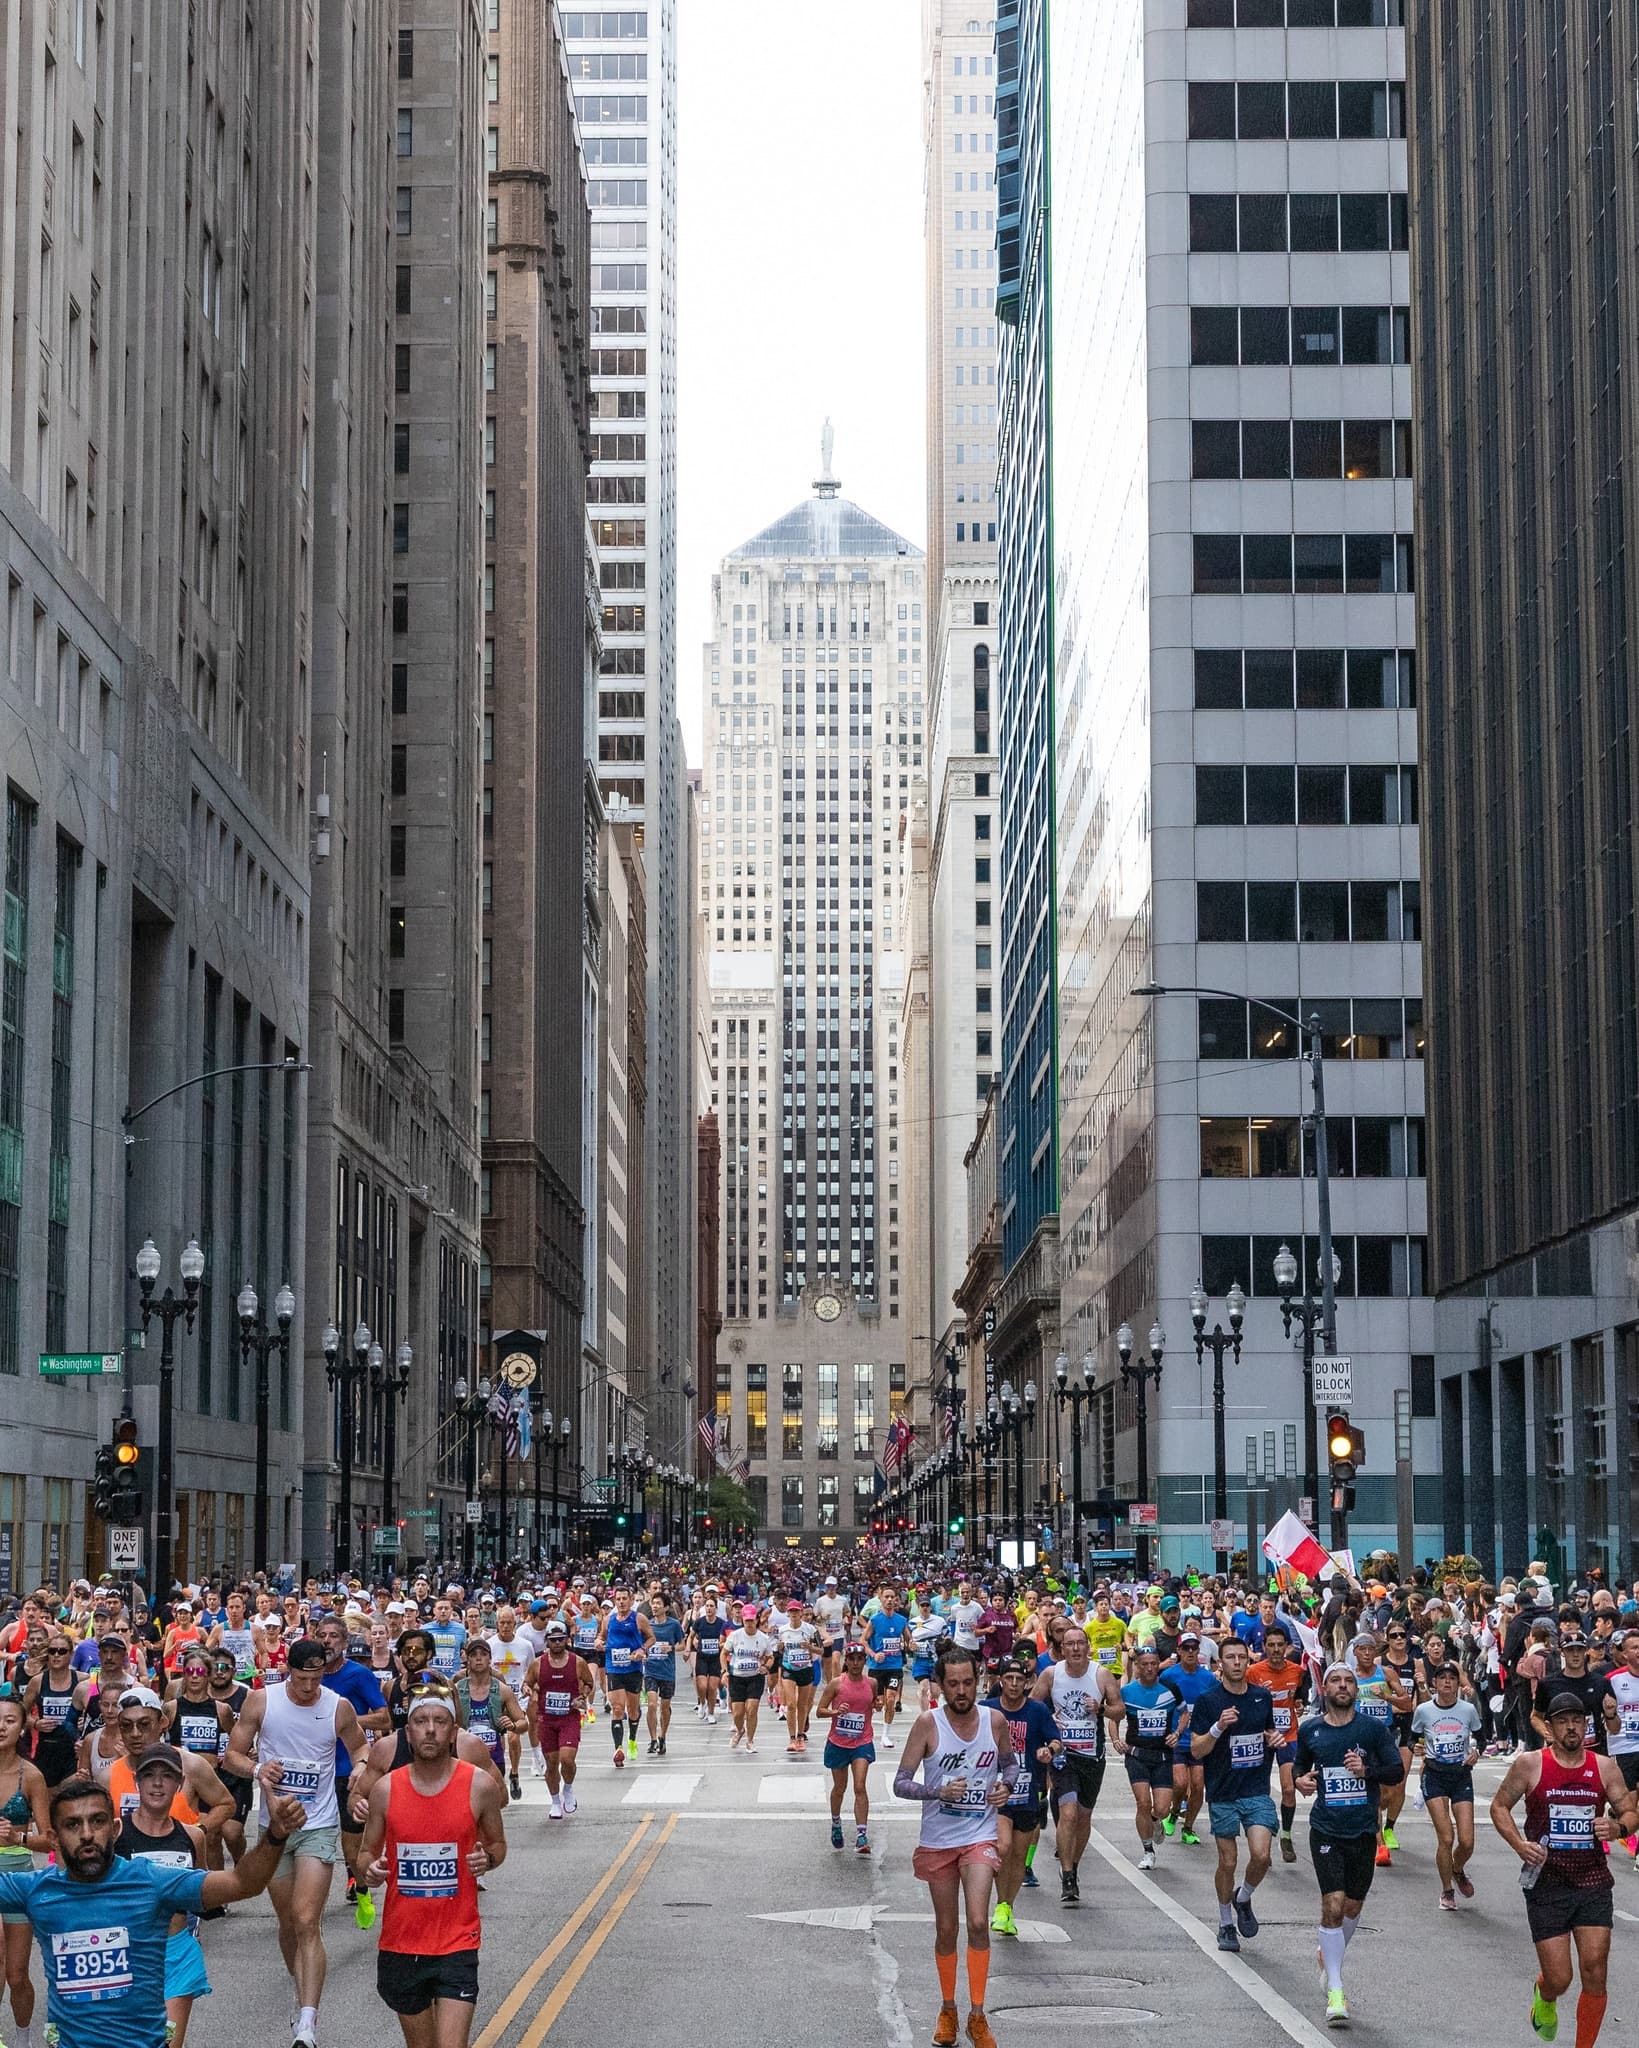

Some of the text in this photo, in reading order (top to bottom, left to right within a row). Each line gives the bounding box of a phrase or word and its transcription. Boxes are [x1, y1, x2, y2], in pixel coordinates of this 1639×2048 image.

[48, 1357, 92, 1373] Washington
[1315, 1362, 1350, 1374] DO NOT
[1315, 1378, 1351, 1390] BLOCK
[1315, 1392, 1352, 1401] INTERSECTION
[113, 1531, 137, 1541] ONE
[113, 1542, 137, 1553] WAY
[43, 1706, 49, 1715] E
[836, 1719, 865, 1729] E 12180
[1138, 1718, 1167, 1728] E 7975
[182, 1726, 217, 1738] E 4086
[1062, 1729, 1095, 1738] D 18485
[1232, 1746, 1239, 1757] E
[1434, 1742, 1465, 1754] E 4966
[281, 1771, 318, 1787] 21812
[1325, 1778, 1367, 1793] E 3820
[959, 1790, 986, 1804] 962
[1545, 1788, 1599, 1798] playmakers
[1550, 1819, 1559, 1832] E
[398, 1860, 457, 1877] E 16023
[56, 1948, 130, 1979] E 8954
